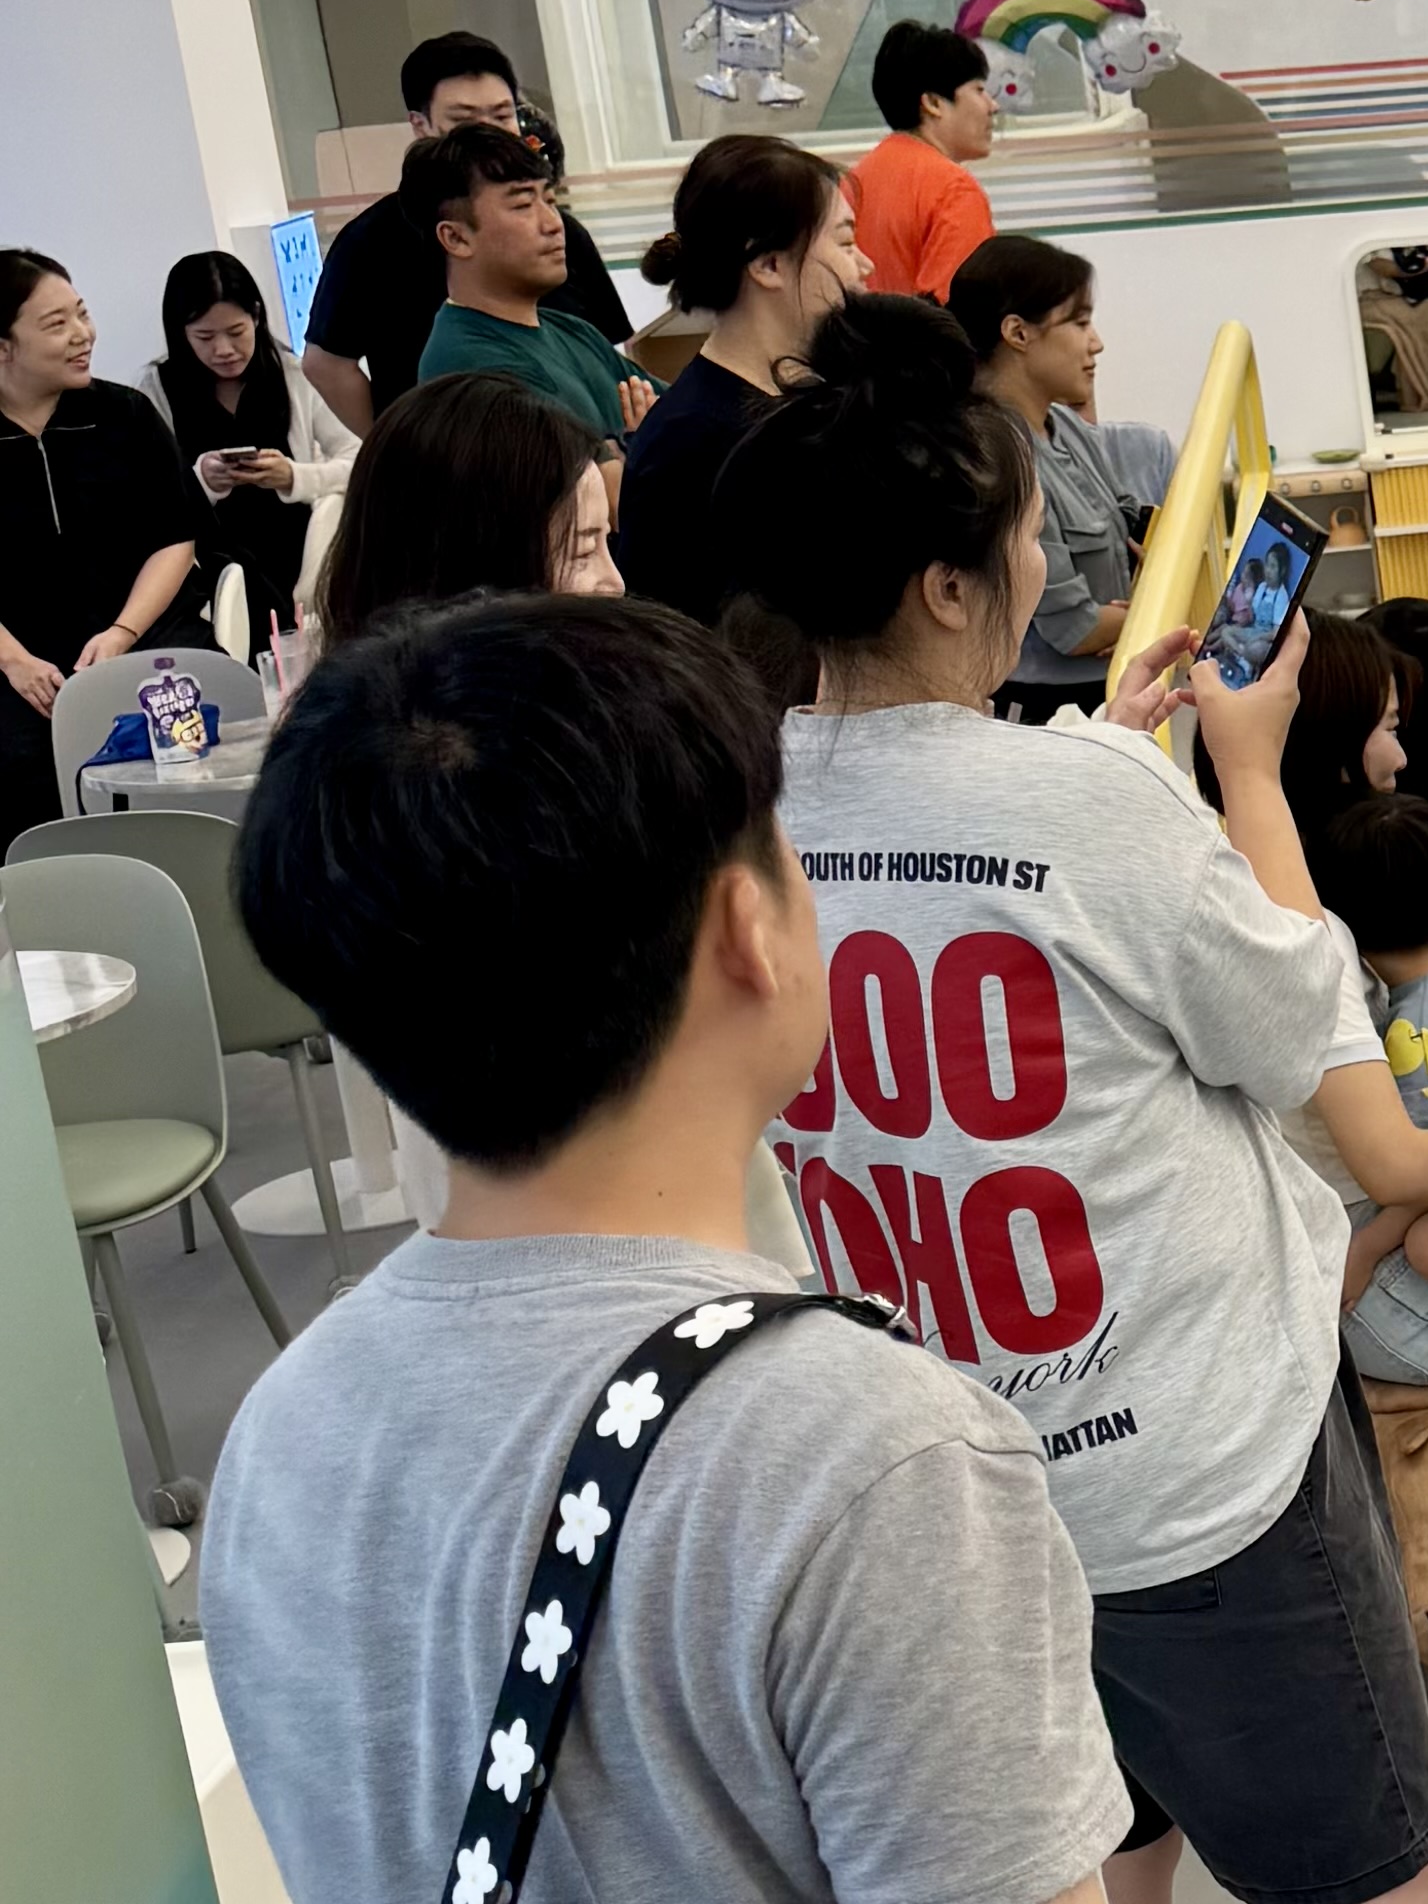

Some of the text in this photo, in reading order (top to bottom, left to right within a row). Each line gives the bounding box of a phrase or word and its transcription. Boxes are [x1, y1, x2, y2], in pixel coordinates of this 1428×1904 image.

[799, 851, 1050, 893] OUTH OF HOUSTON ST
[774, 1141, 1104, 1365] OHO
